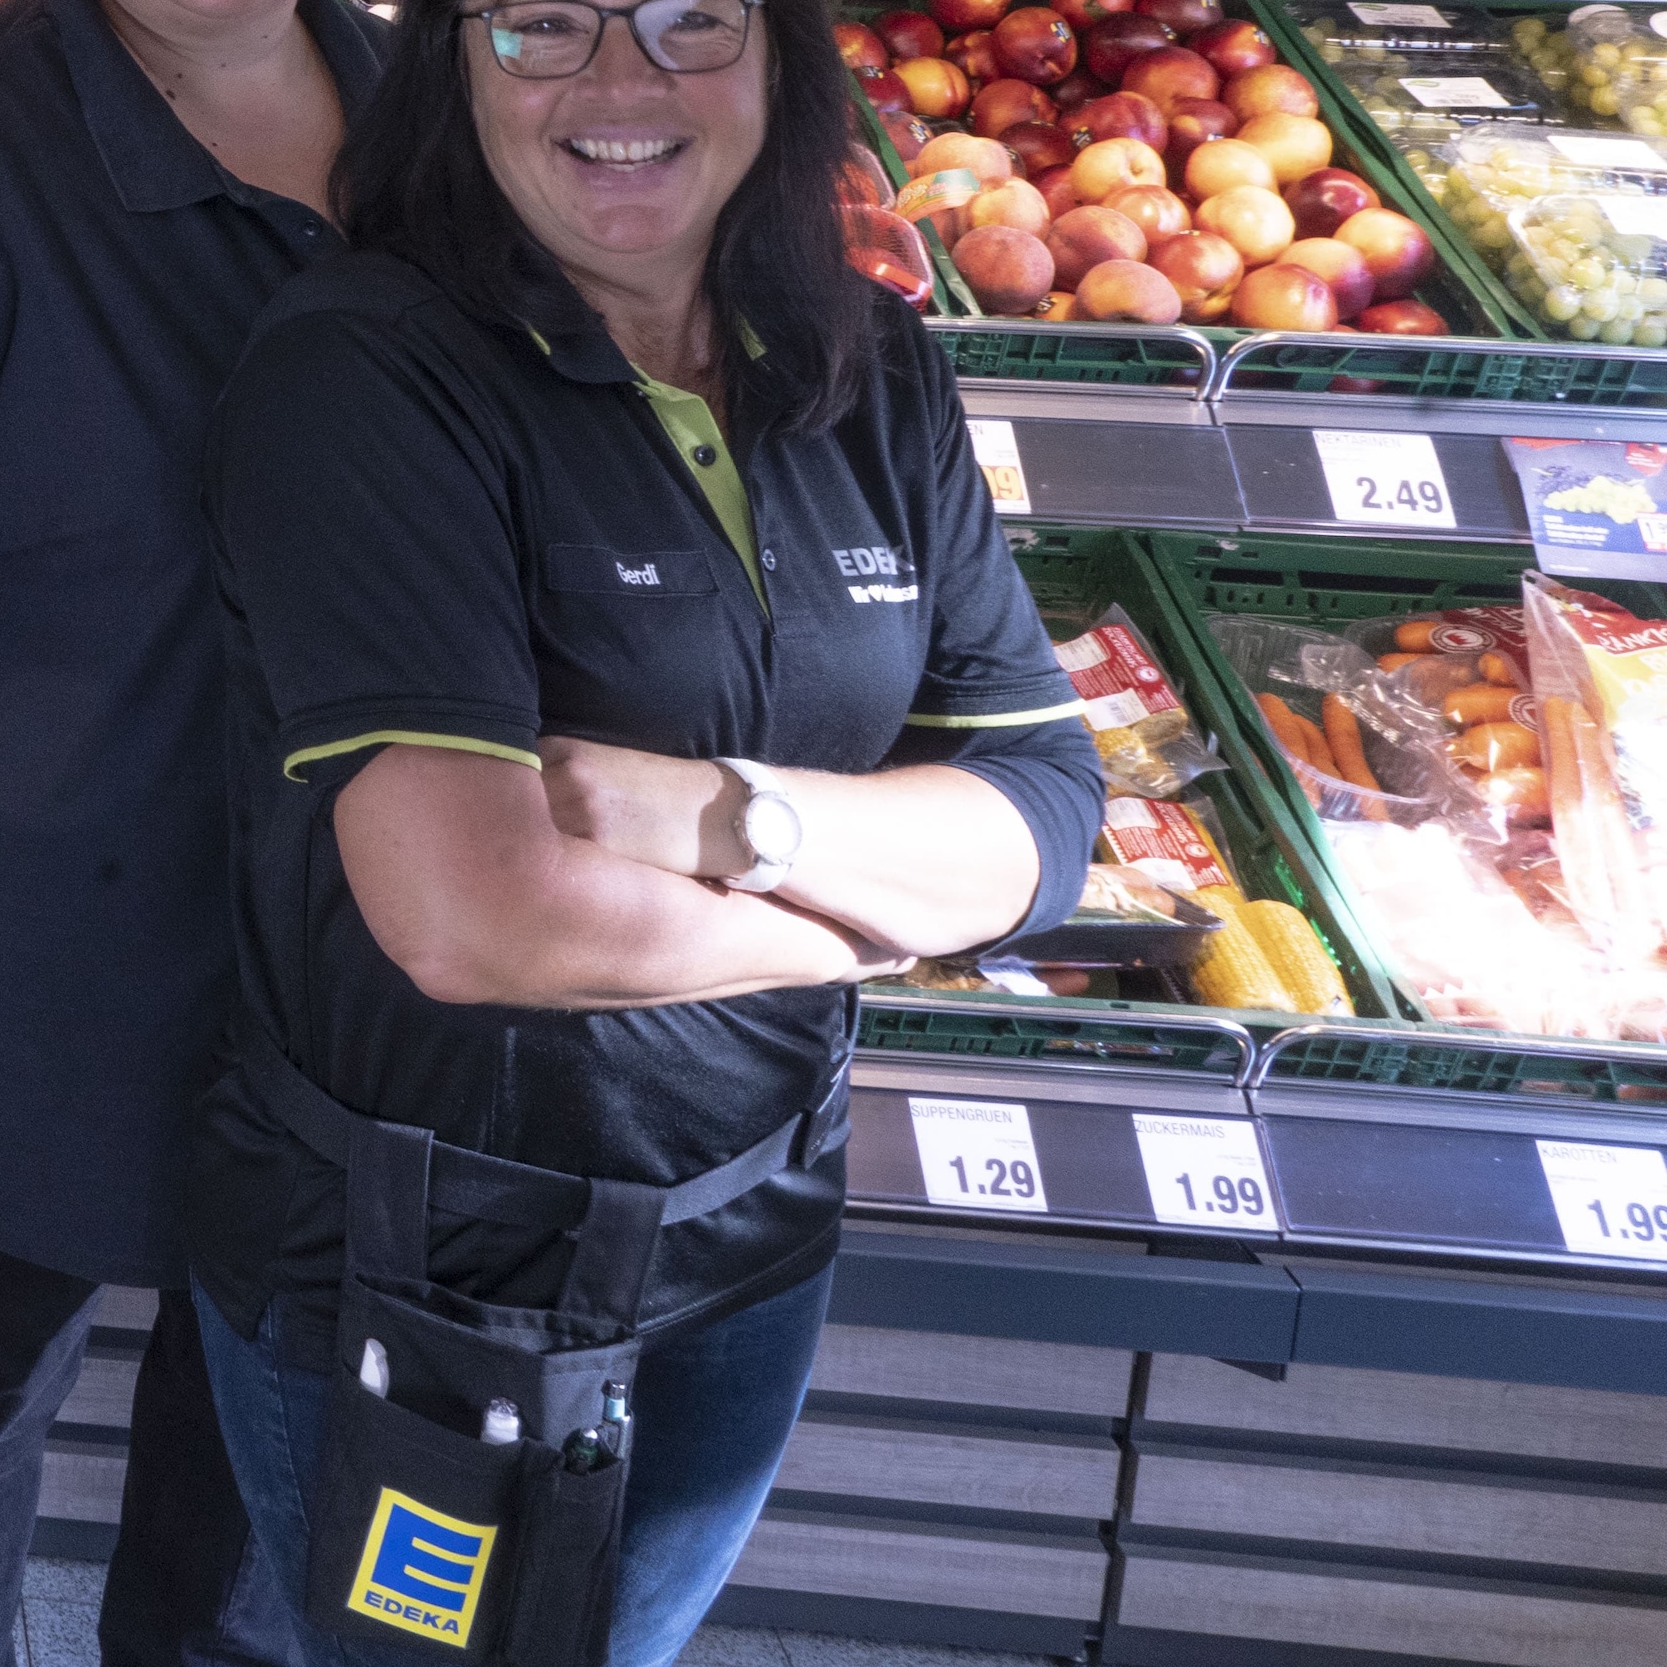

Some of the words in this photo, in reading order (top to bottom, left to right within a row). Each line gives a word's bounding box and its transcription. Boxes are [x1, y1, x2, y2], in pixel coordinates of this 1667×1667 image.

[1356, 476, 1443, 513] 2.49
[616, 561, 661, 585] Gerdi
[911, 1104, 1012, 1123] SUPPENGRUEN
[1133, 1119, 1226, 1138] ZUCKERMAIS
[1540, 1147, 1618, 1163] KAROTTEN
[949, 1155, 1036, 1199] 1.29
[1175, 1173, 1264, 1216] 1.99
[371, 1503, 482, 1612] E
[364, 1590, 460, 1635] EDEKA
